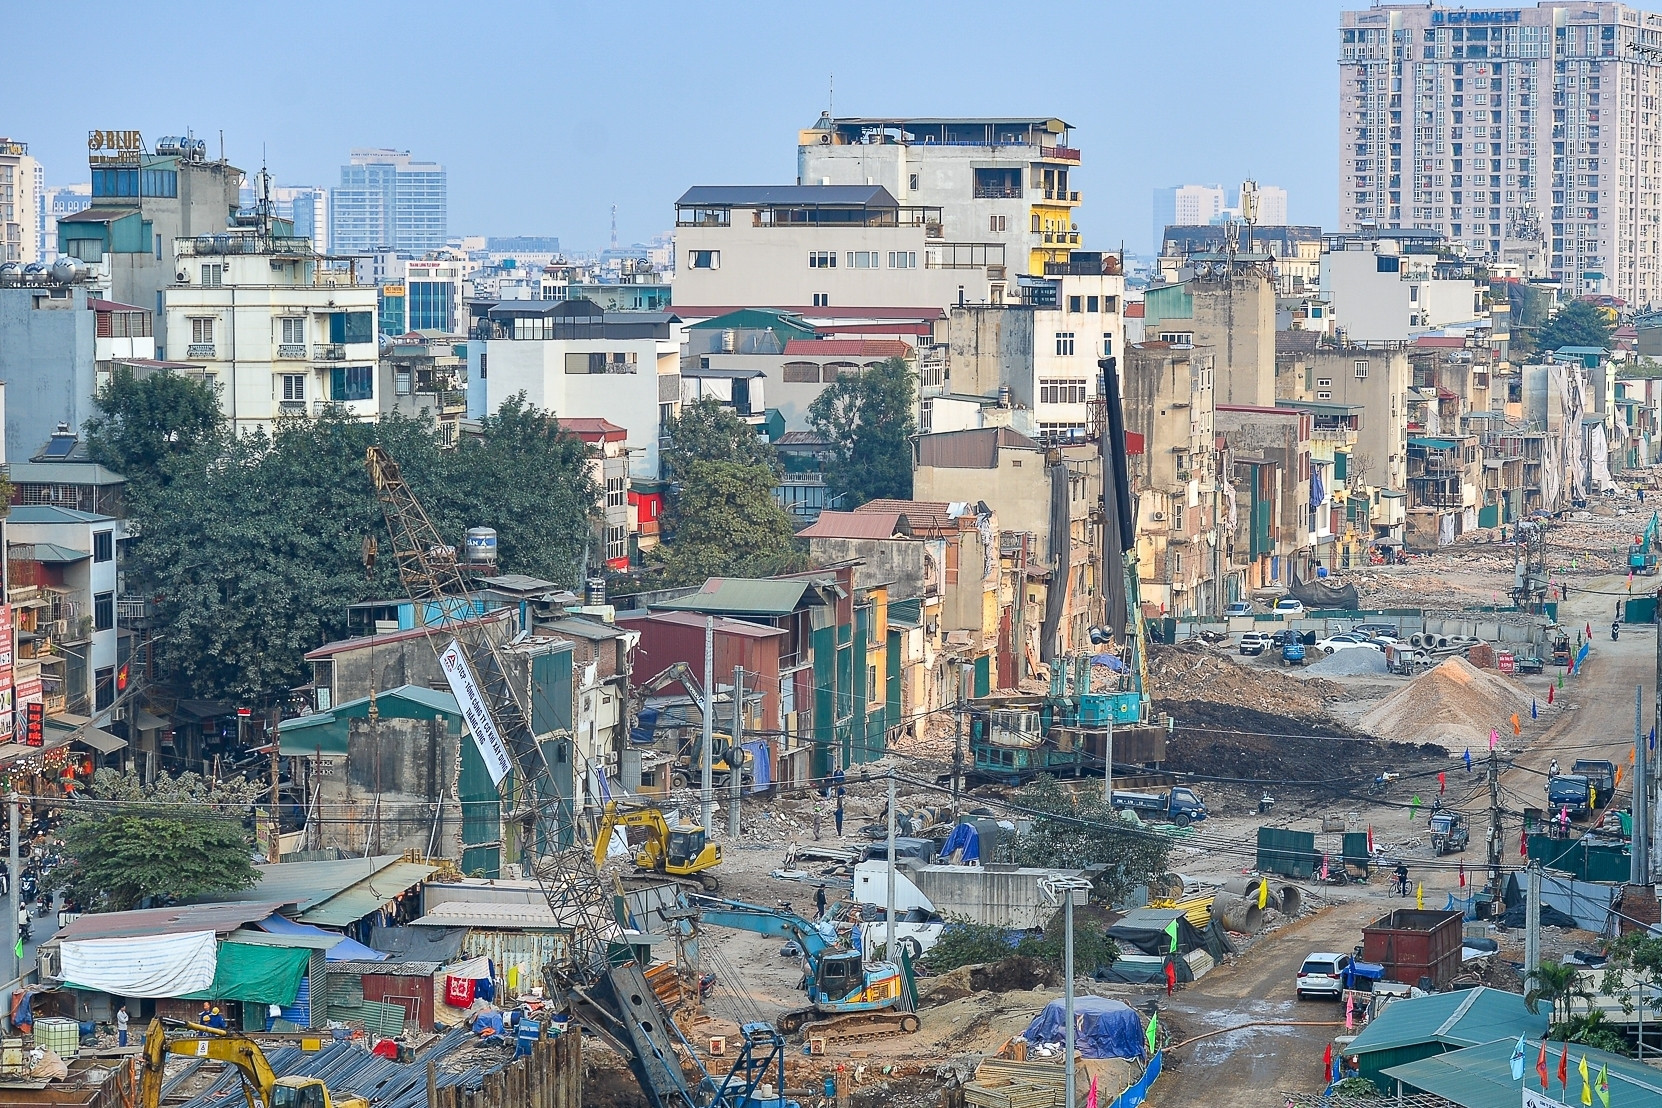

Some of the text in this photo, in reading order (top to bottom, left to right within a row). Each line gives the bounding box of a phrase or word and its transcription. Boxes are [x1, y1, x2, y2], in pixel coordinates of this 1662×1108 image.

[106, 131, 140, 149] BLUE
[457, 663, 467, 680] CTCP
[472, 698, 483, 716] CÔNG
[480, 714, 486, 724] TY
[487, 731, 496, 744] KHÍ
[492, 741, 501, 756] XÂY
[475, 726, 486, 745] LONG
